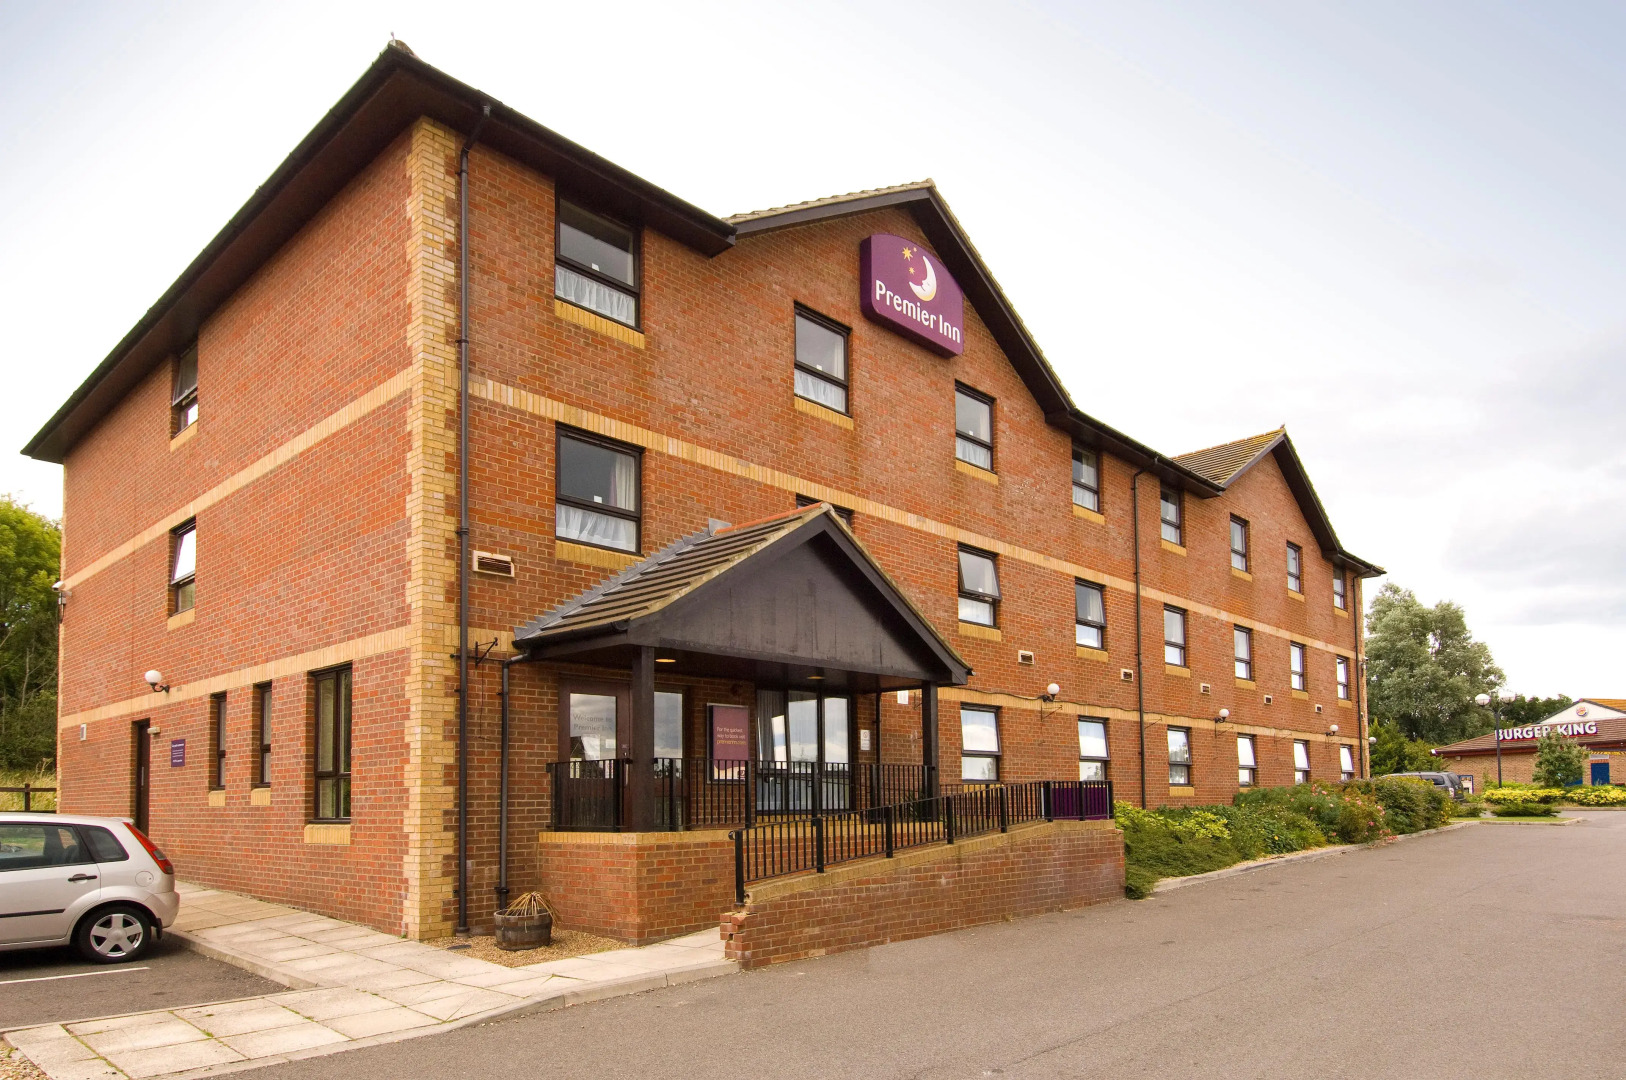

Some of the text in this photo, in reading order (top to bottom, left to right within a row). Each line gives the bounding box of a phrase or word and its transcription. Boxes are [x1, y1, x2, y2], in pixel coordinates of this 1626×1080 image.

[876, 280, 960, 343] Premier Inn
[573, 713, 604, 722] Welcome
[1557, 722, 1597, 736] KING
